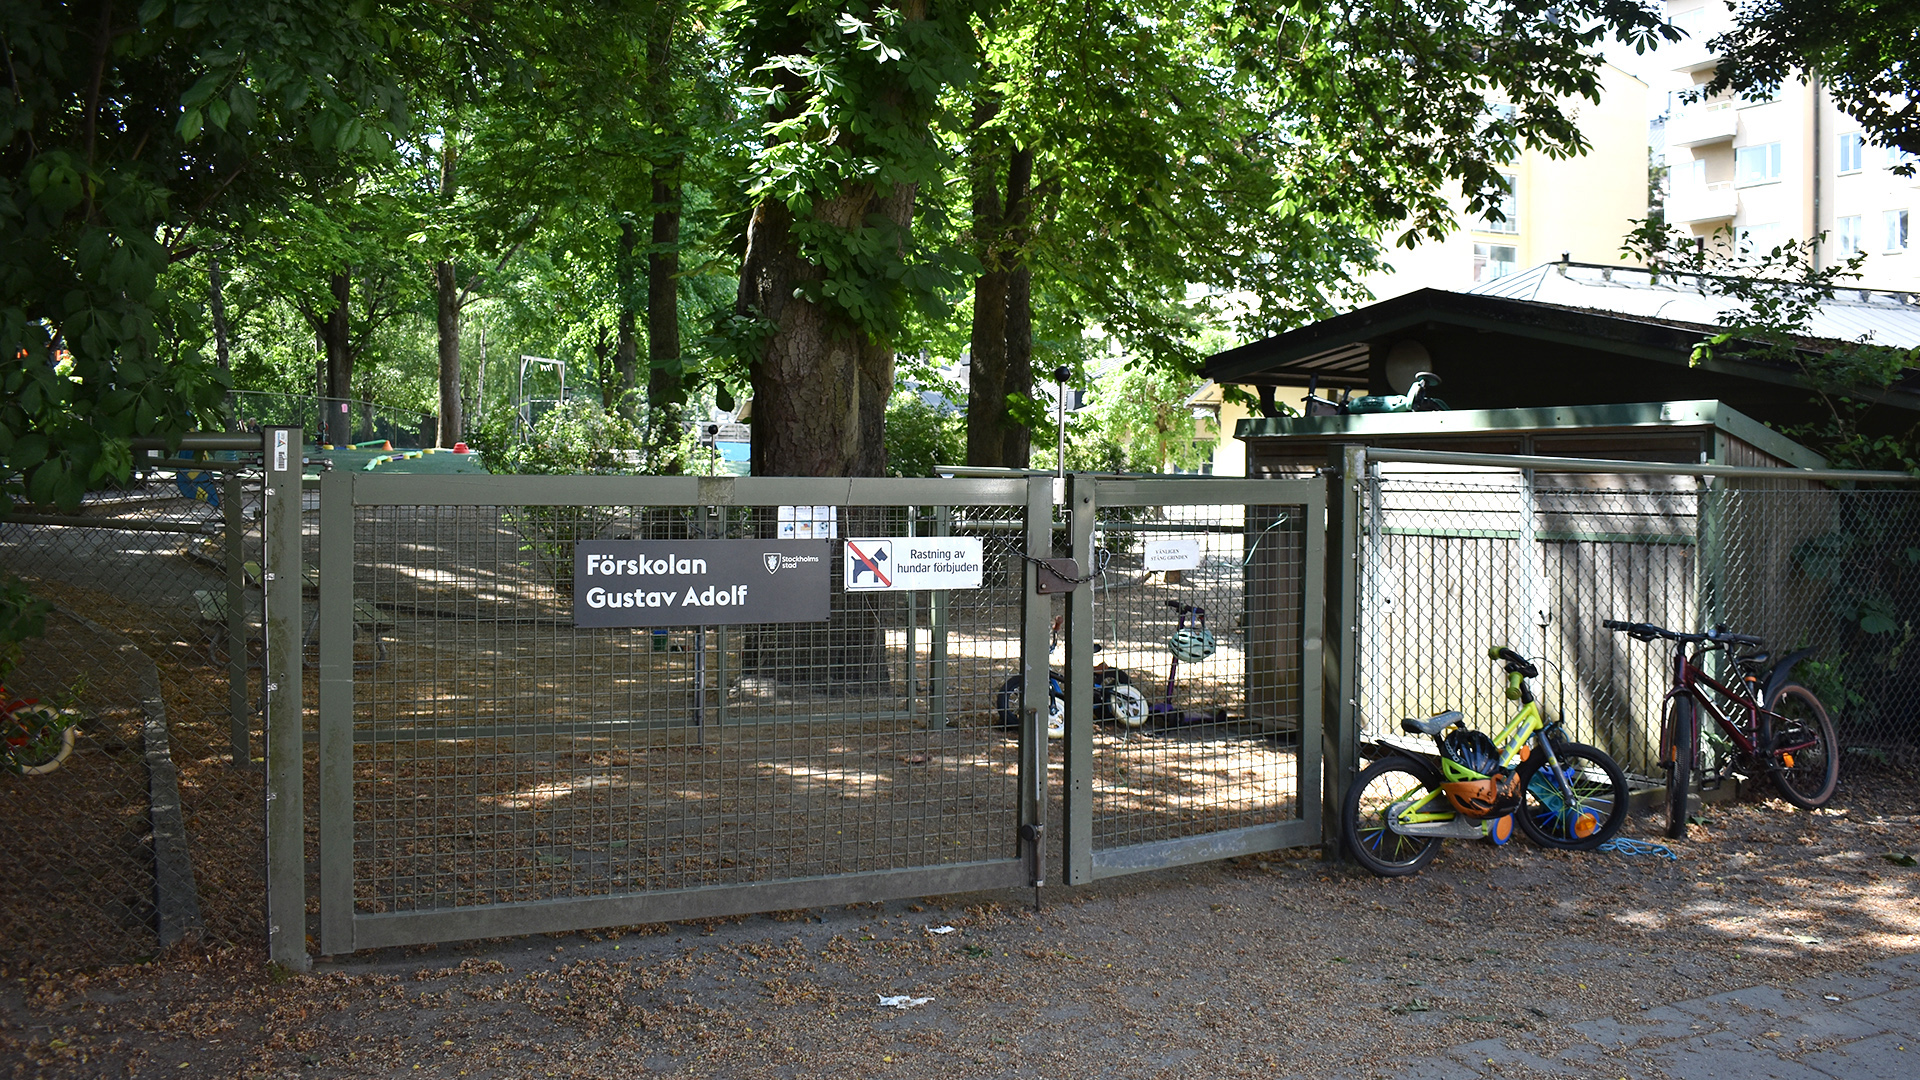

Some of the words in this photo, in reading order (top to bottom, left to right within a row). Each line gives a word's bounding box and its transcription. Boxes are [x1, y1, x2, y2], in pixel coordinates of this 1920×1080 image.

[910, 549, 952, 560] Rastning
[954, 550, 966, 559] av
[587, 554, 706, 576] Förskolan
[897, 562, 931, 574] hundar
[934, 562, 978, 574] förbjuden
[586, 587, 677, 608] Gustav
[682, 585, 748, 606] Adolf
